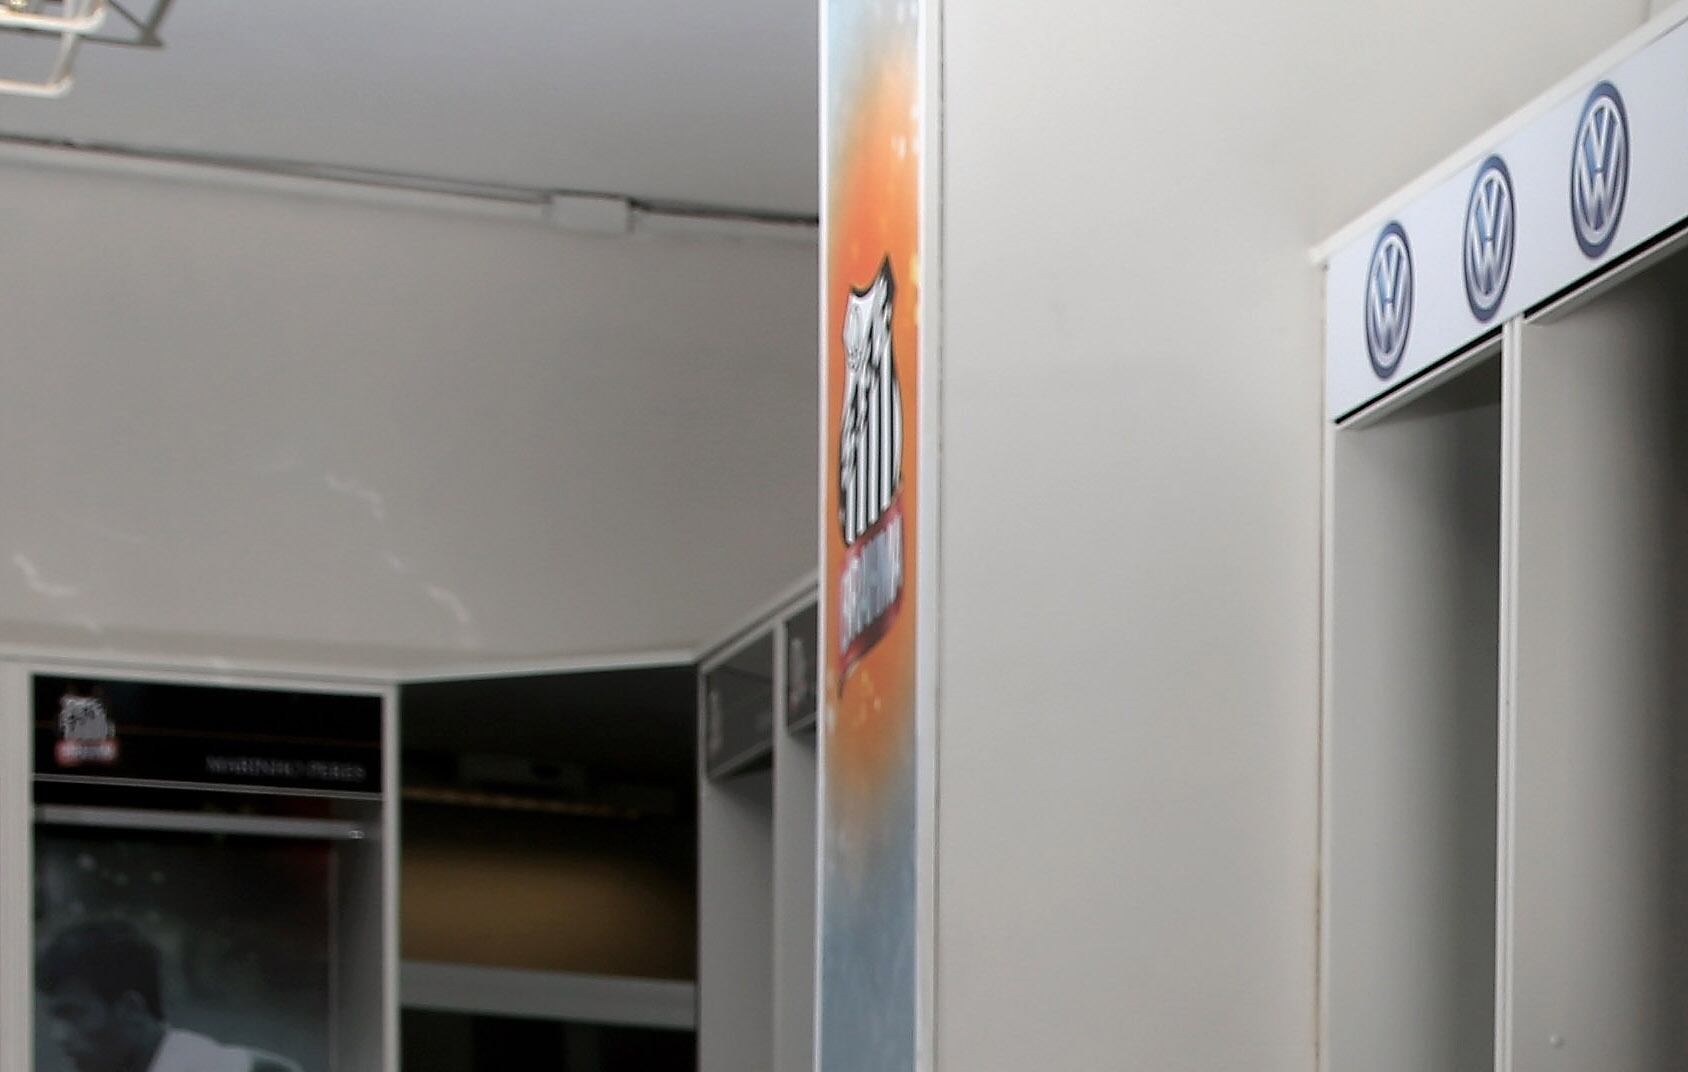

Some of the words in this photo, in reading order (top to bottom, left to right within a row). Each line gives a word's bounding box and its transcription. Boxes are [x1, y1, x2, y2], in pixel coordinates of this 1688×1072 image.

[1465, 168, 1511, 309] VW
[1574, 97, 1627, 242] VW
[1367, 233, 1410, 366] VW
